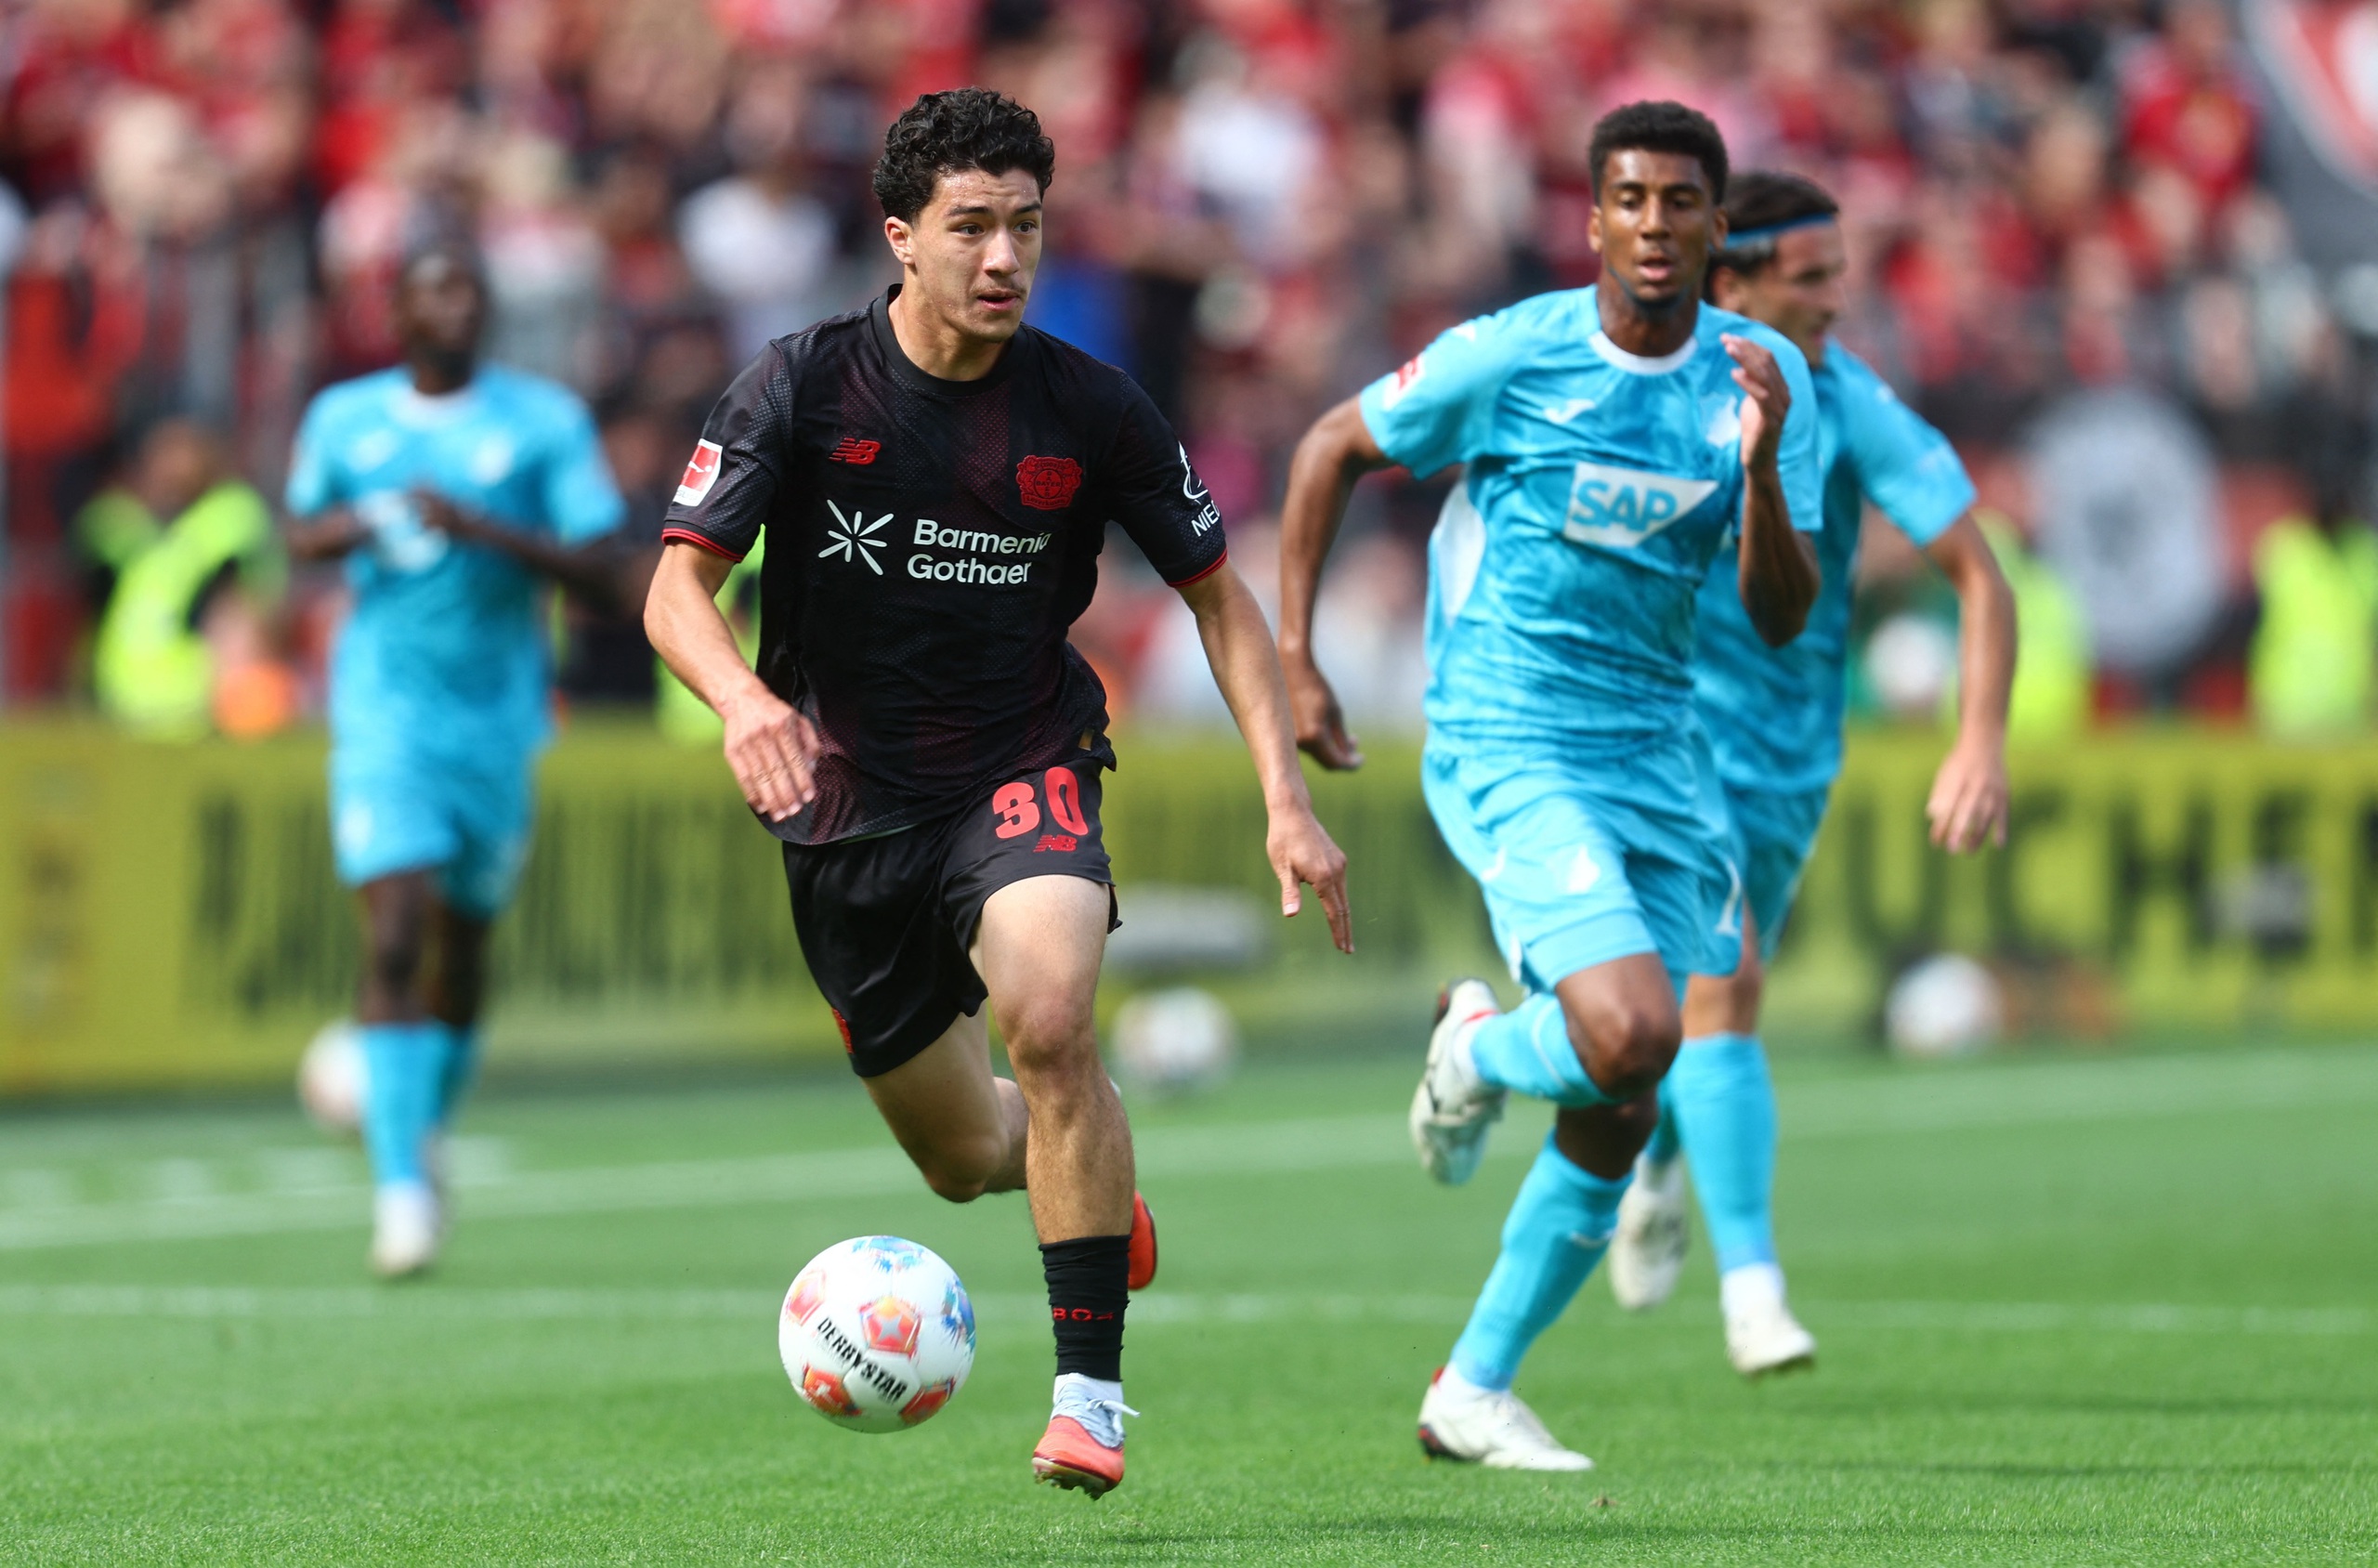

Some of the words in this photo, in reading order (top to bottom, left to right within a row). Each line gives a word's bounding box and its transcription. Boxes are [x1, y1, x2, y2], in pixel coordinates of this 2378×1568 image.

[1572, 479, 1677, 531] SAP
[913, 518, 1052, 554] Barmenia
[907, 555, 1032, 585] Gothaer
[992, 766, 1089, 839] 30
